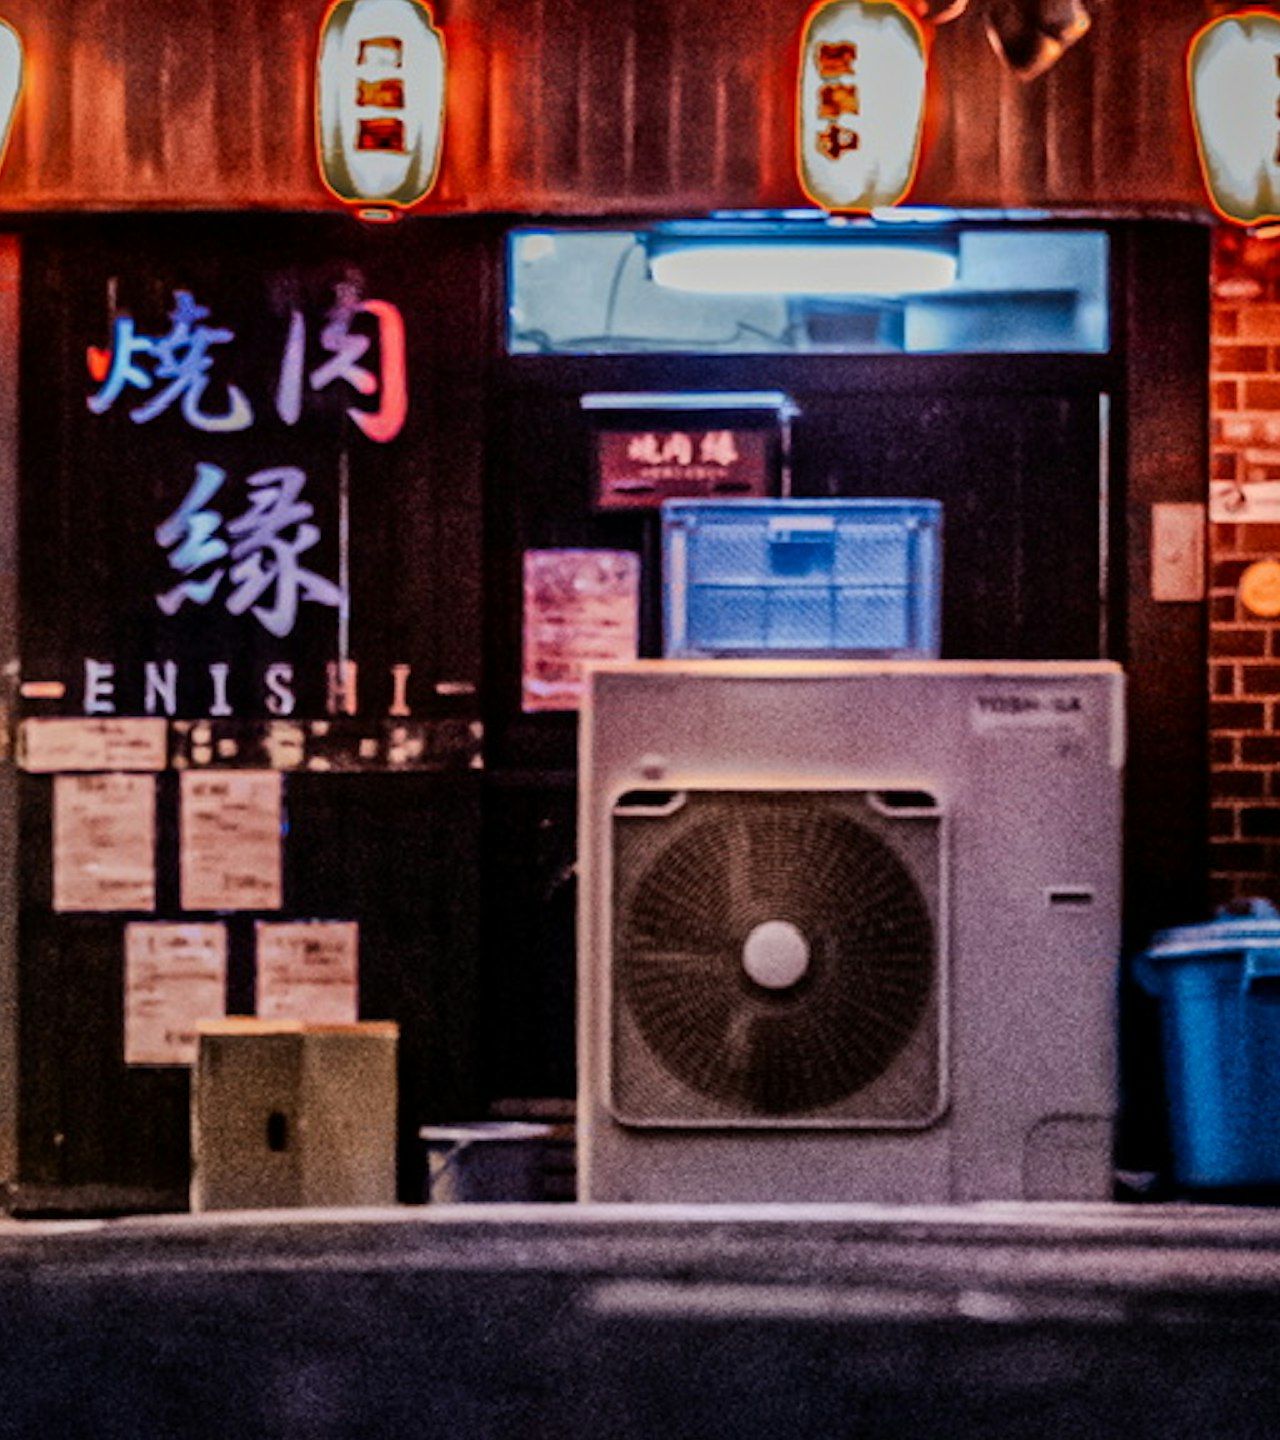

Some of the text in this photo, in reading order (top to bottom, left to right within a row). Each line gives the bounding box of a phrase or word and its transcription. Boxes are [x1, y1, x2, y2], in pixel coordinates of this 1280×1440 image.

[85, 272, 409, 443] 焼肉
[154, 461, 342, 638] 縁
[82, 658, 412, 717] ENISHI
